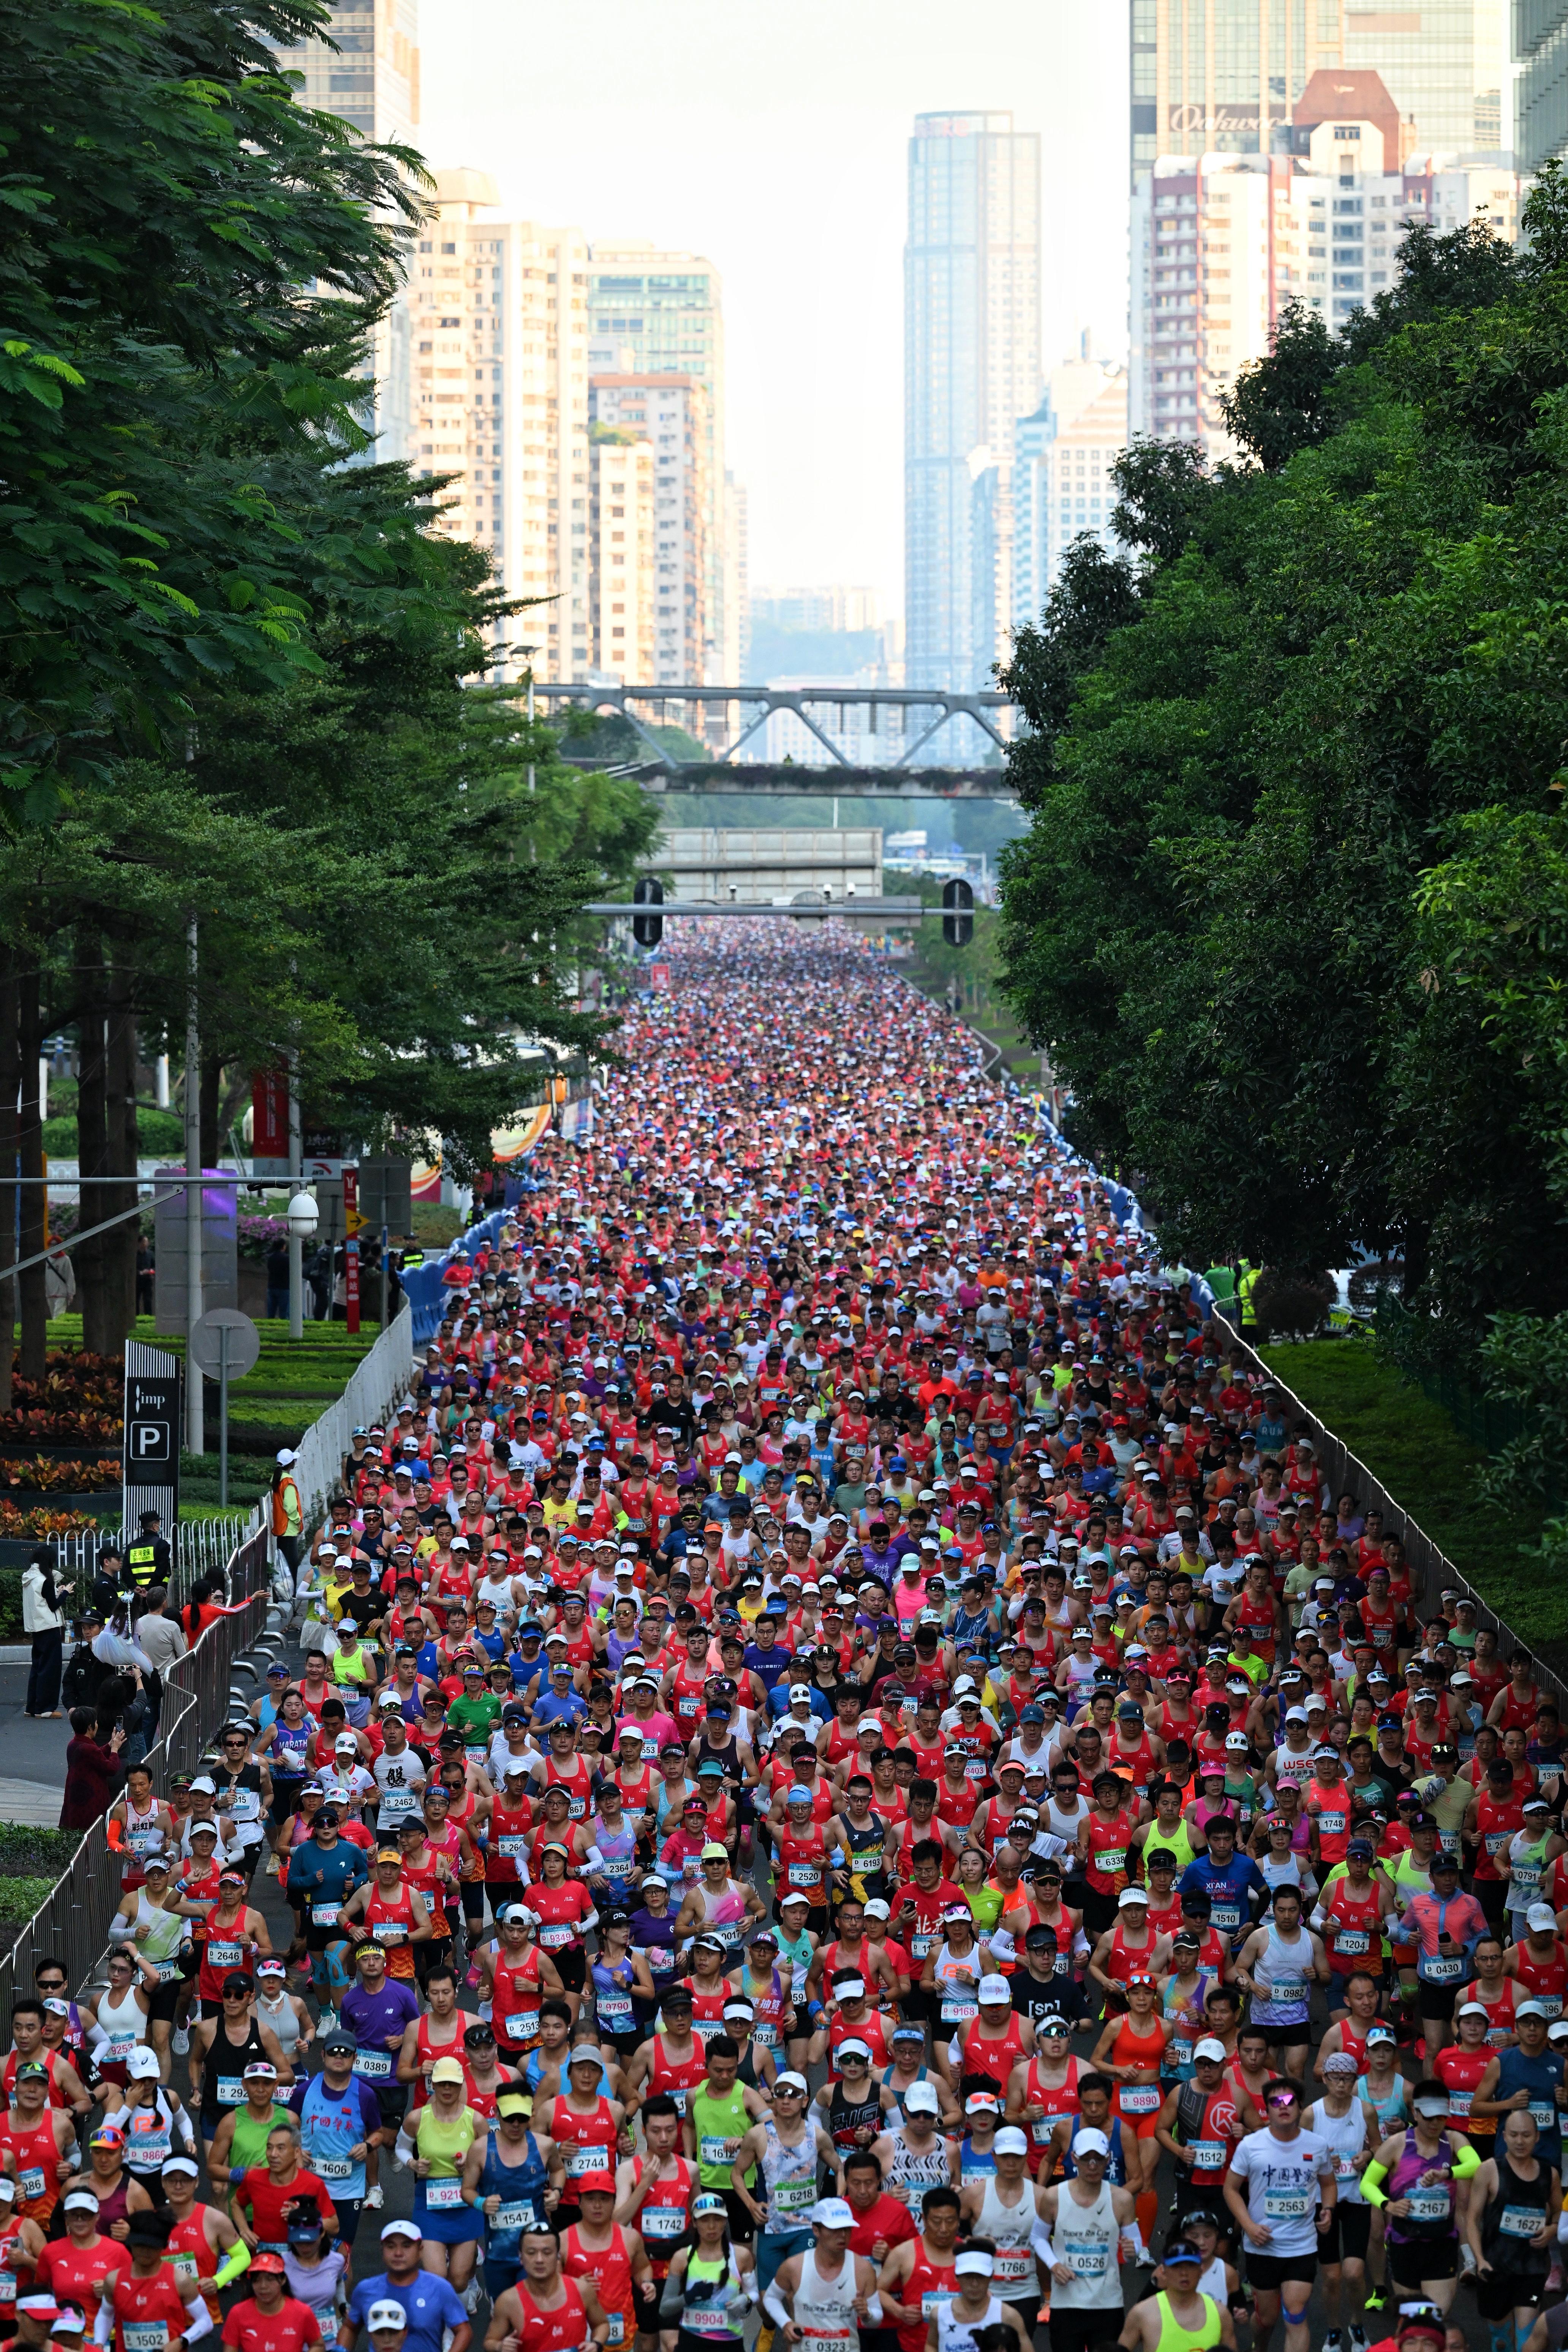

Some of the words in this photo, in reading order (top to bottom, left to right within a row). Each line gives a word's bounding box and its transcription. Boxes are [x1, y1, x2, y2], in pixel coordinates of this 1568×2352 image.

[142, 1392, 165, 1410] imp
[1262, 1427, 1282, 1435] RUN
[140, 1428, 160, 1455] P
[279, 1740, 308, 1750] MARATH
[569, 1805, 583, 1813] 867
[1442, 1838, 1456, 1847] 1121
[863, 1858, 880, 1867] 6193
[1106, 1856, 1125, 1865] 6338
[609, 1864, 629, 1872] 2364
[798, 1872, 818, 1881] 2520
[1518, 1871, 1536, 1881] 0791
[323, 1912, 337, 1920] 967
[1216, 1914, 1235, 1923] 1510
[915, 1914, 942, 1934] 北京
[550, 1933, 571, 1943] 9349
[1345, 1940, 1365, 1949] 1204
[217, 1952, 239, 1960] 2646
[1055, 1963, 1066, 1971] 783
[1437, 1964, 1459, 1974] 0430
[792, 1993, 803, 2002] 59
[1283, 1988, 1304, 1997] 0982
[606, 2002, 628, 2012] 9790
[953, 2007, 975, 2016] 9168
[520, 2021, 539, 2032] 2513
[754, 2033, 773, 2043] 1931
[364, 2061, 387, 2072] 0389
[1133, 2095, 1157, 2106] 9890
[143, 2150, 165, 2161] 9866
[1200, 2153, 1221, 2162] 1512
[579, 2158, 604, 2169] 2744
[322, 2164, 347, 2174] 1606
[790, 2189, 813, 2201] 6218
[1279, 2201, 1305, 2212] 2563
[1420, 2202, 1445, 2214] 2167
[503, 2212, 528, 2223] 1547
[658, 2219, 681, 2230] 1742
[1517, 2219, 1541, 2230] 1627
[1000, 2262, 1025, 2273] 1766
[1078, 2257, 1104, 2268] 0526
[695, 2314, 724, 2324] 9904
[137, 2335, 163, 2346] 1502
[817, 2343, 846, 2352] 0323
